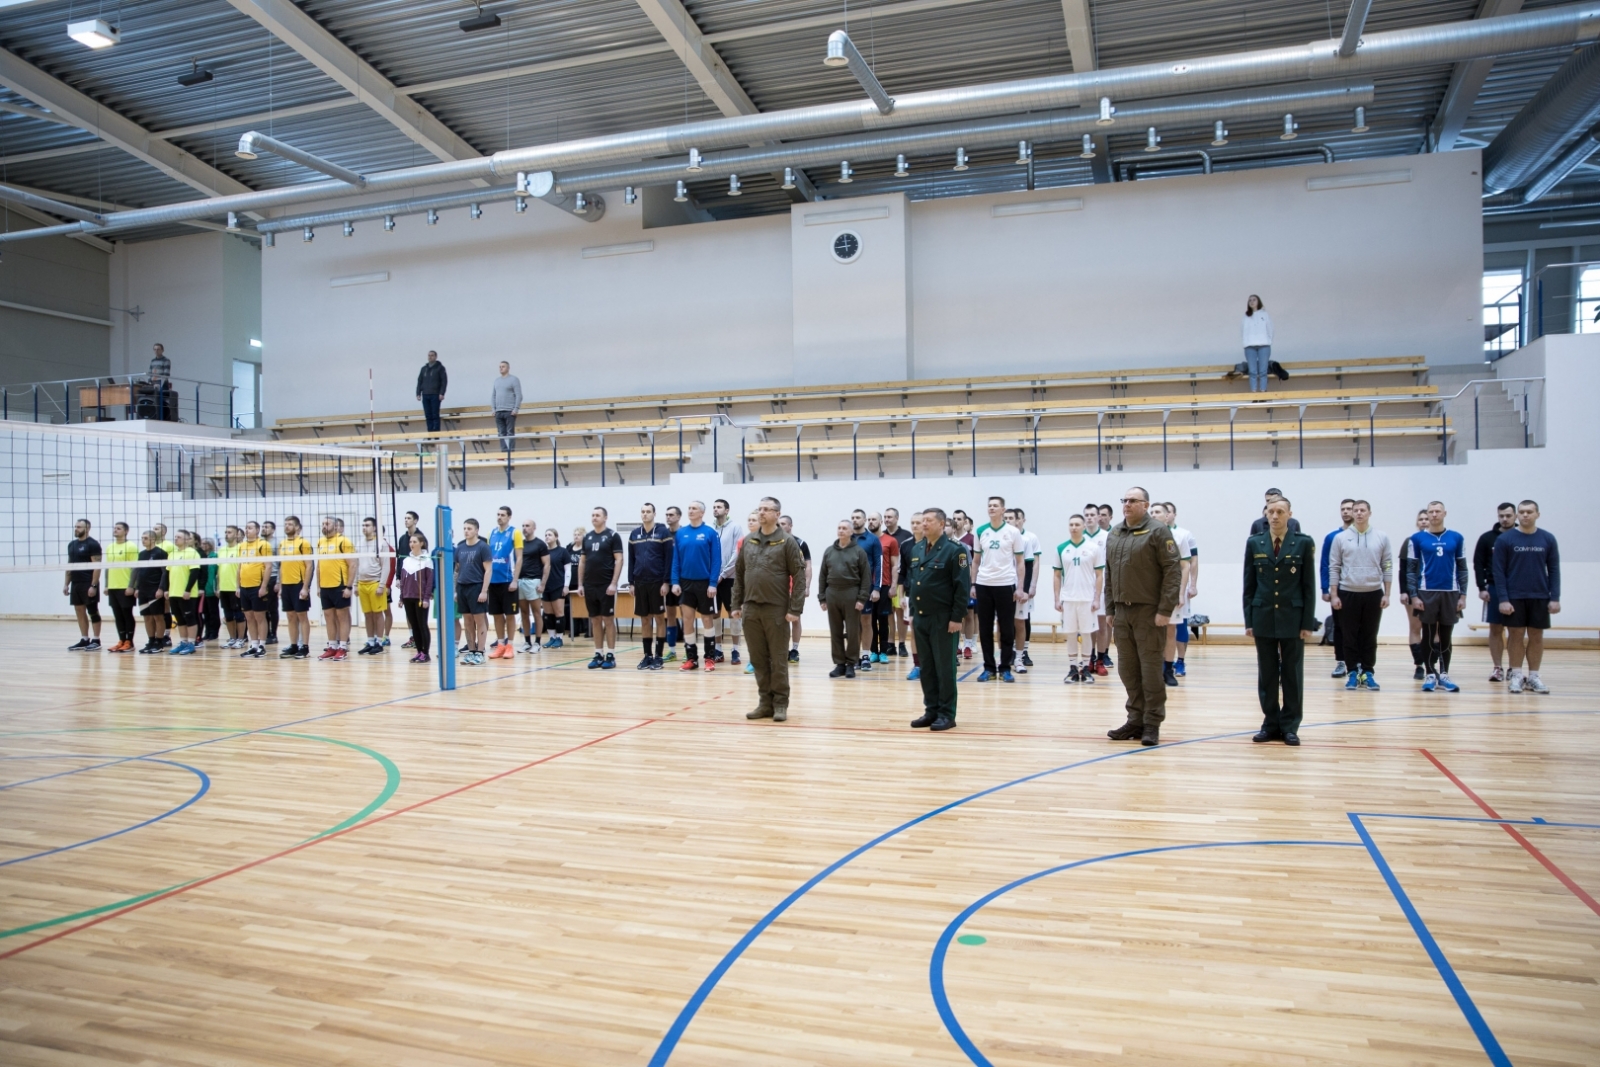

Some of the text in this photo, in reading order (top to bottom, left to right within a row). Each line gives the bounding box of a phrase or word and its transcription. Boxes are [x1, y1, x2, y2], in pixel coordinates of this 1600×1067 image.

[494, 541, 502, 551] 13
[591, 542, 600, 551] 10
[989, 540, 1000, 549] 25
[1436, 546, 1444, 556] 3
[1072, 556, 1080, 566] 11
